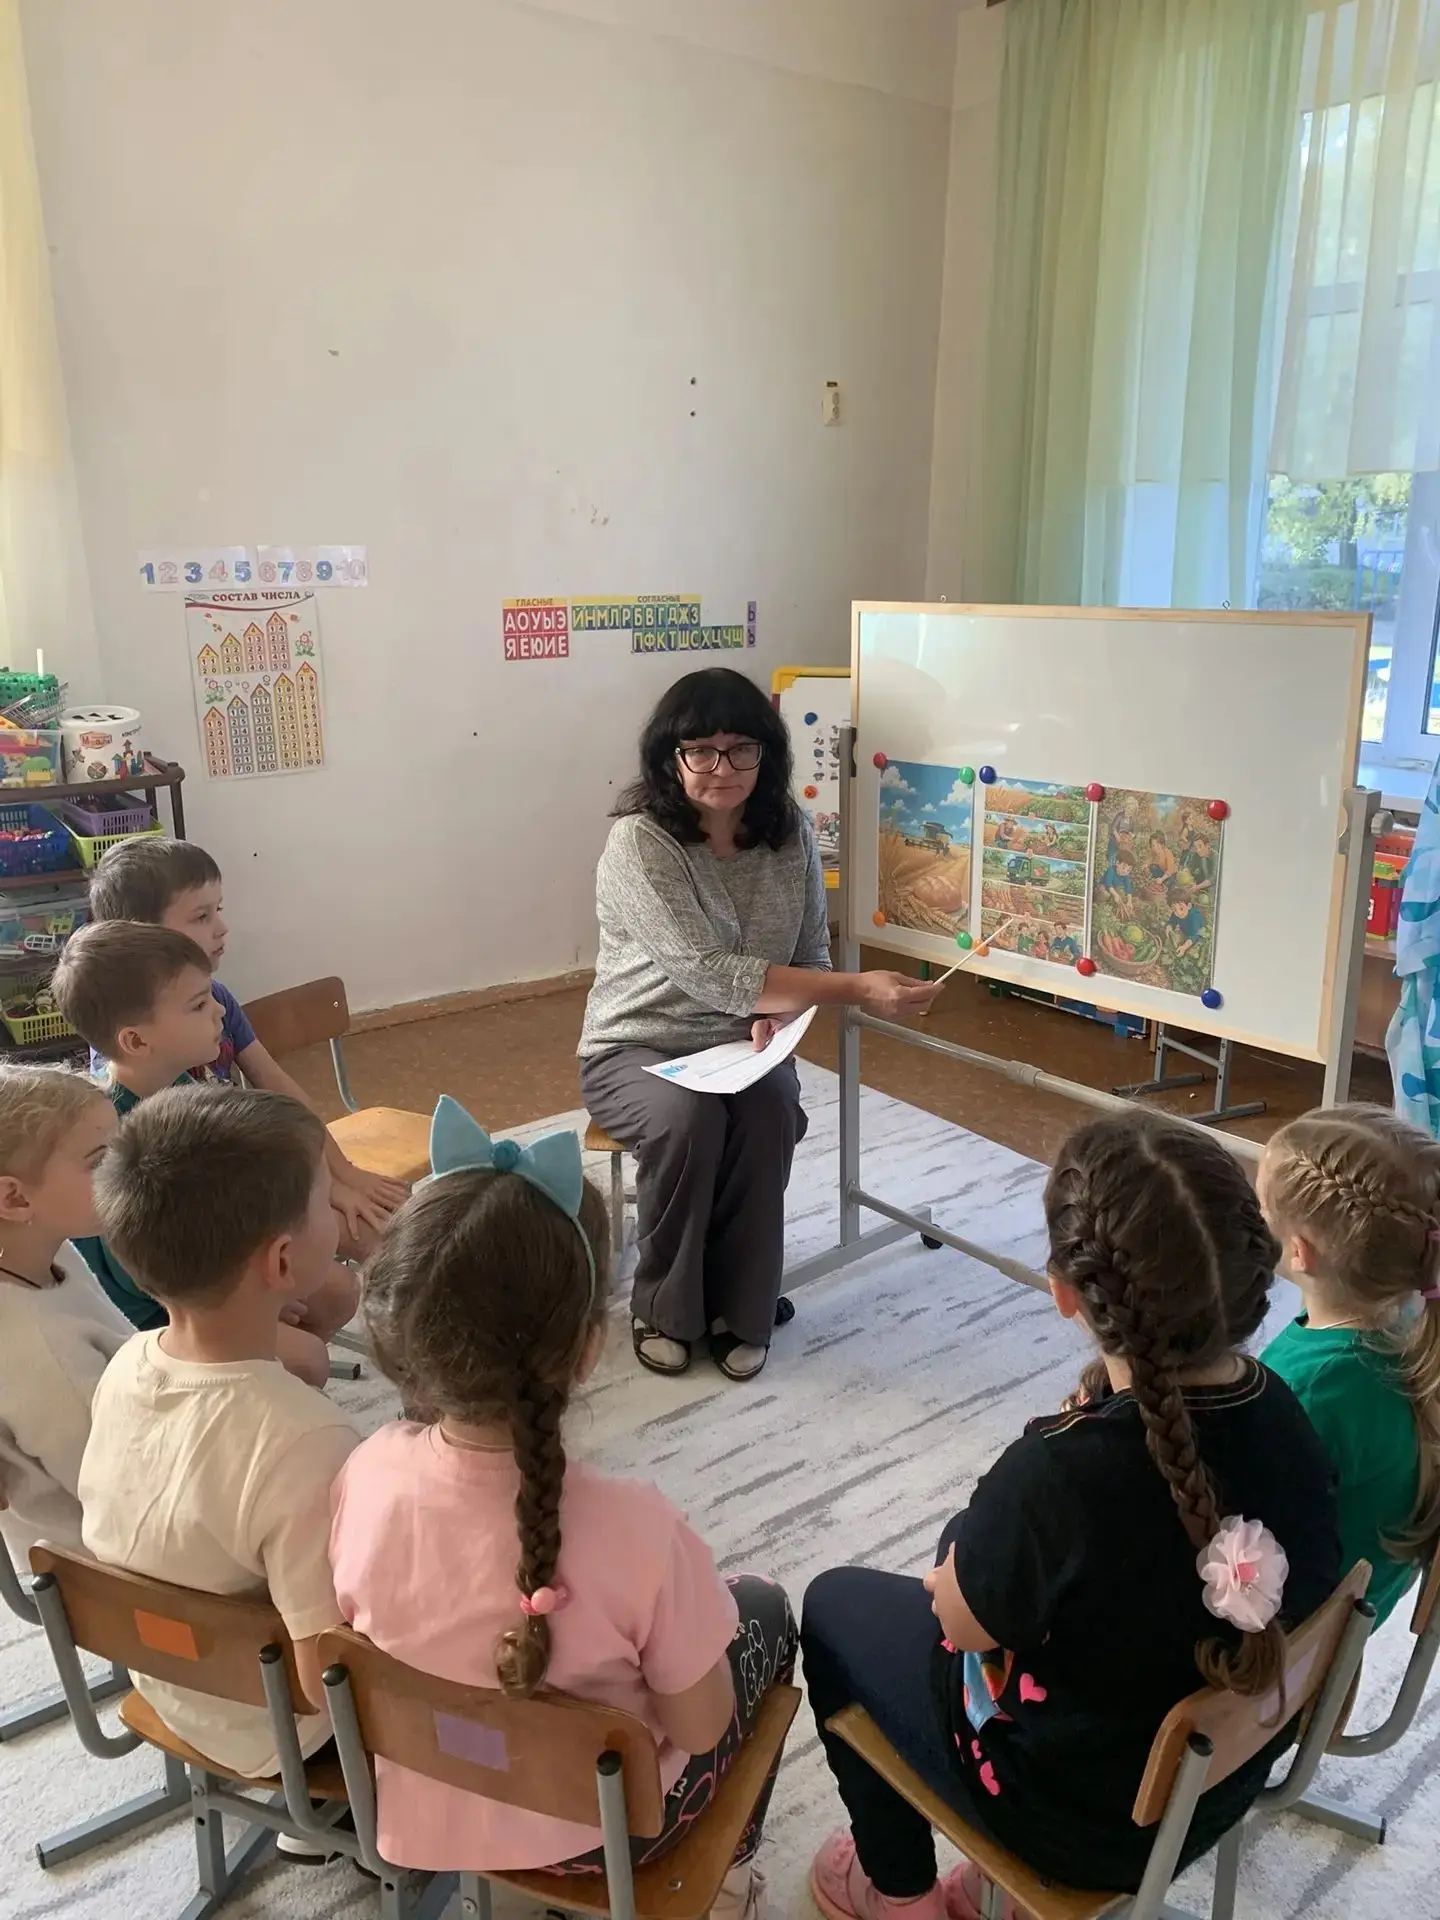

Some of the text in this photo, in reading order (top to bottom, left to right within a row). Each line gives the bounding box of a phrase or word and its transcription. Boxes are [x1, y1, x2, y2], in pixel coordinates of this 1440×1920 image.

[140, 559, 365, 584] 1 2 3 4 5 6 7 8 9 10
[212, 591, 300, 602] СОСТАВ ЧИСЛА
[637, 595, 681, 603] СОГЛАСНЫЕ
